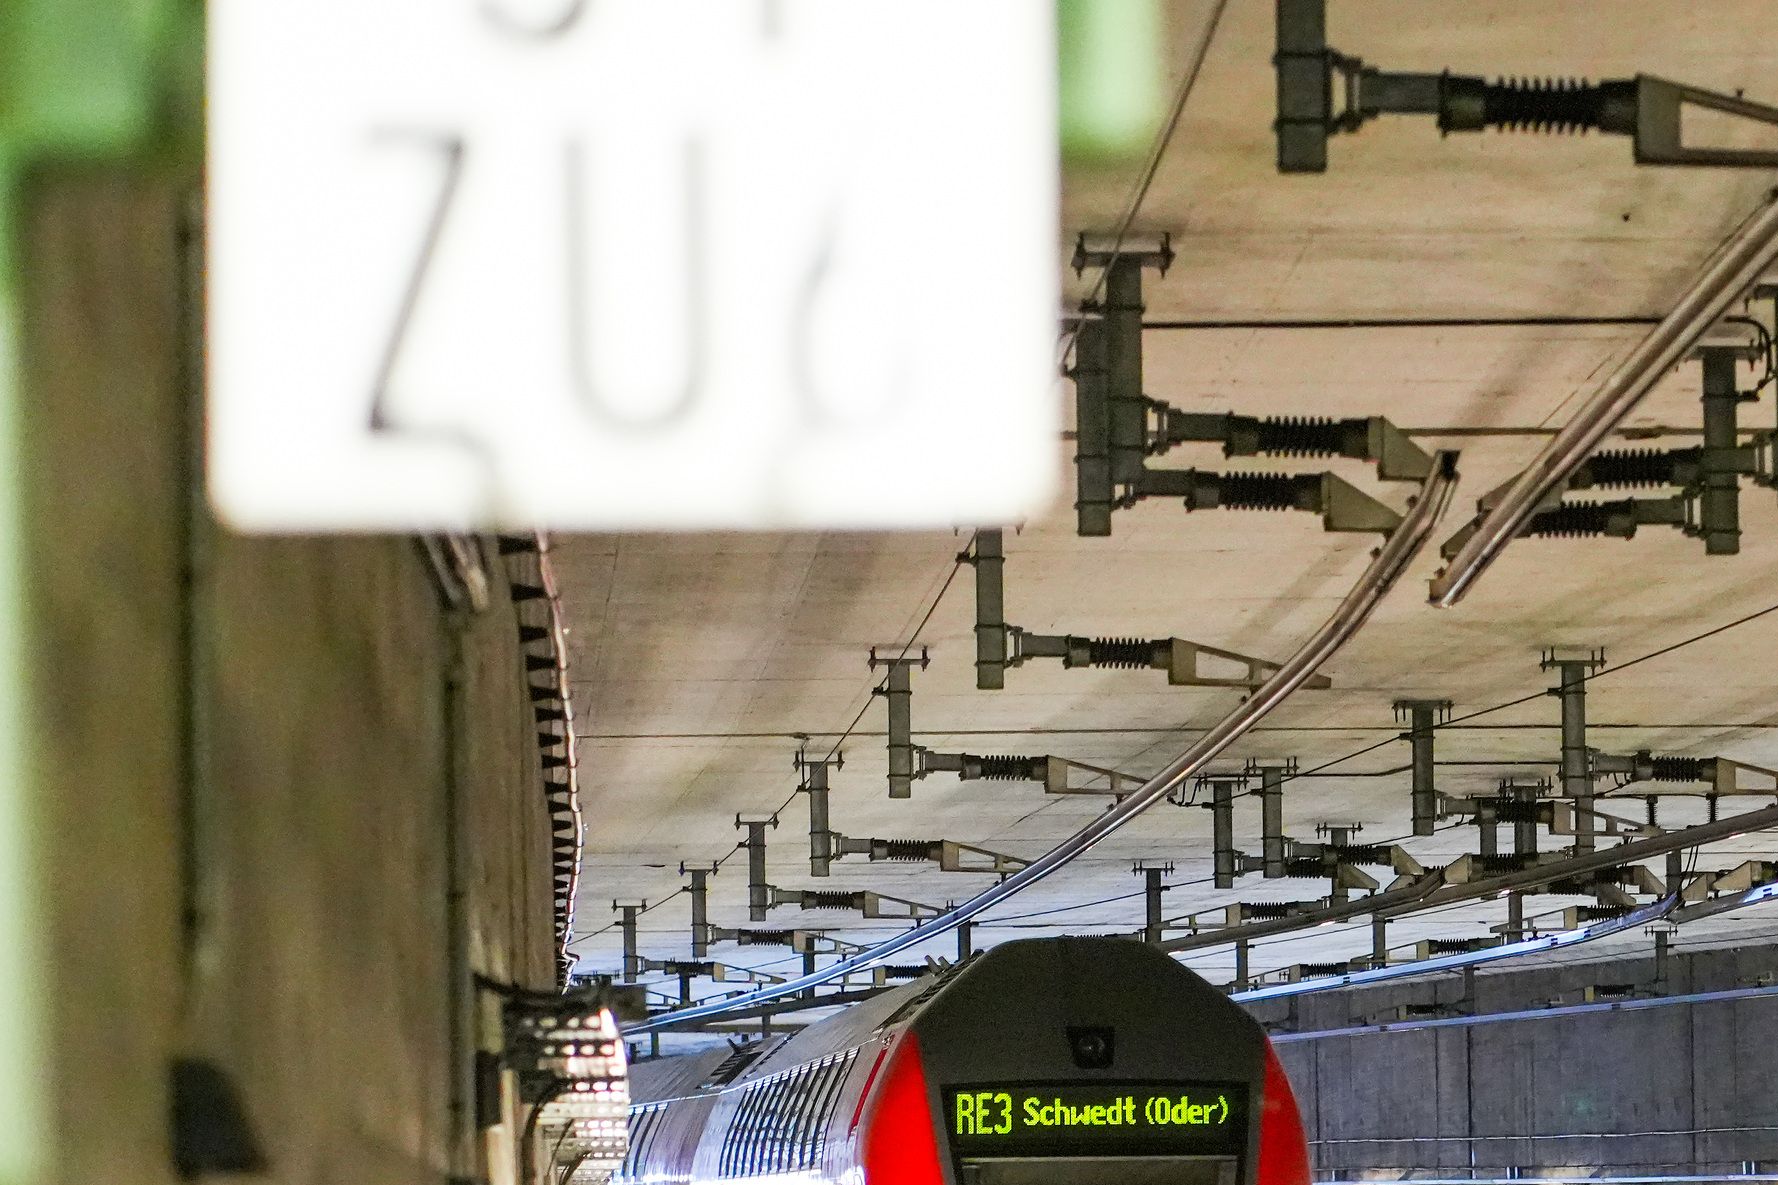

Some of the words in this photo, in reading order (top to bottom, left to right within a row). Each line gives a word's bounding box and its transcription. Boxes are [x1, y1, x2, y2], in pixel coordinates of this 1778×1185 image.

[956, 1092, 1013, 1135] RE3
[1023, 1096, 1137, 1126] Schwedt
[1145, 1095, 1229, 1125] (Oder)
